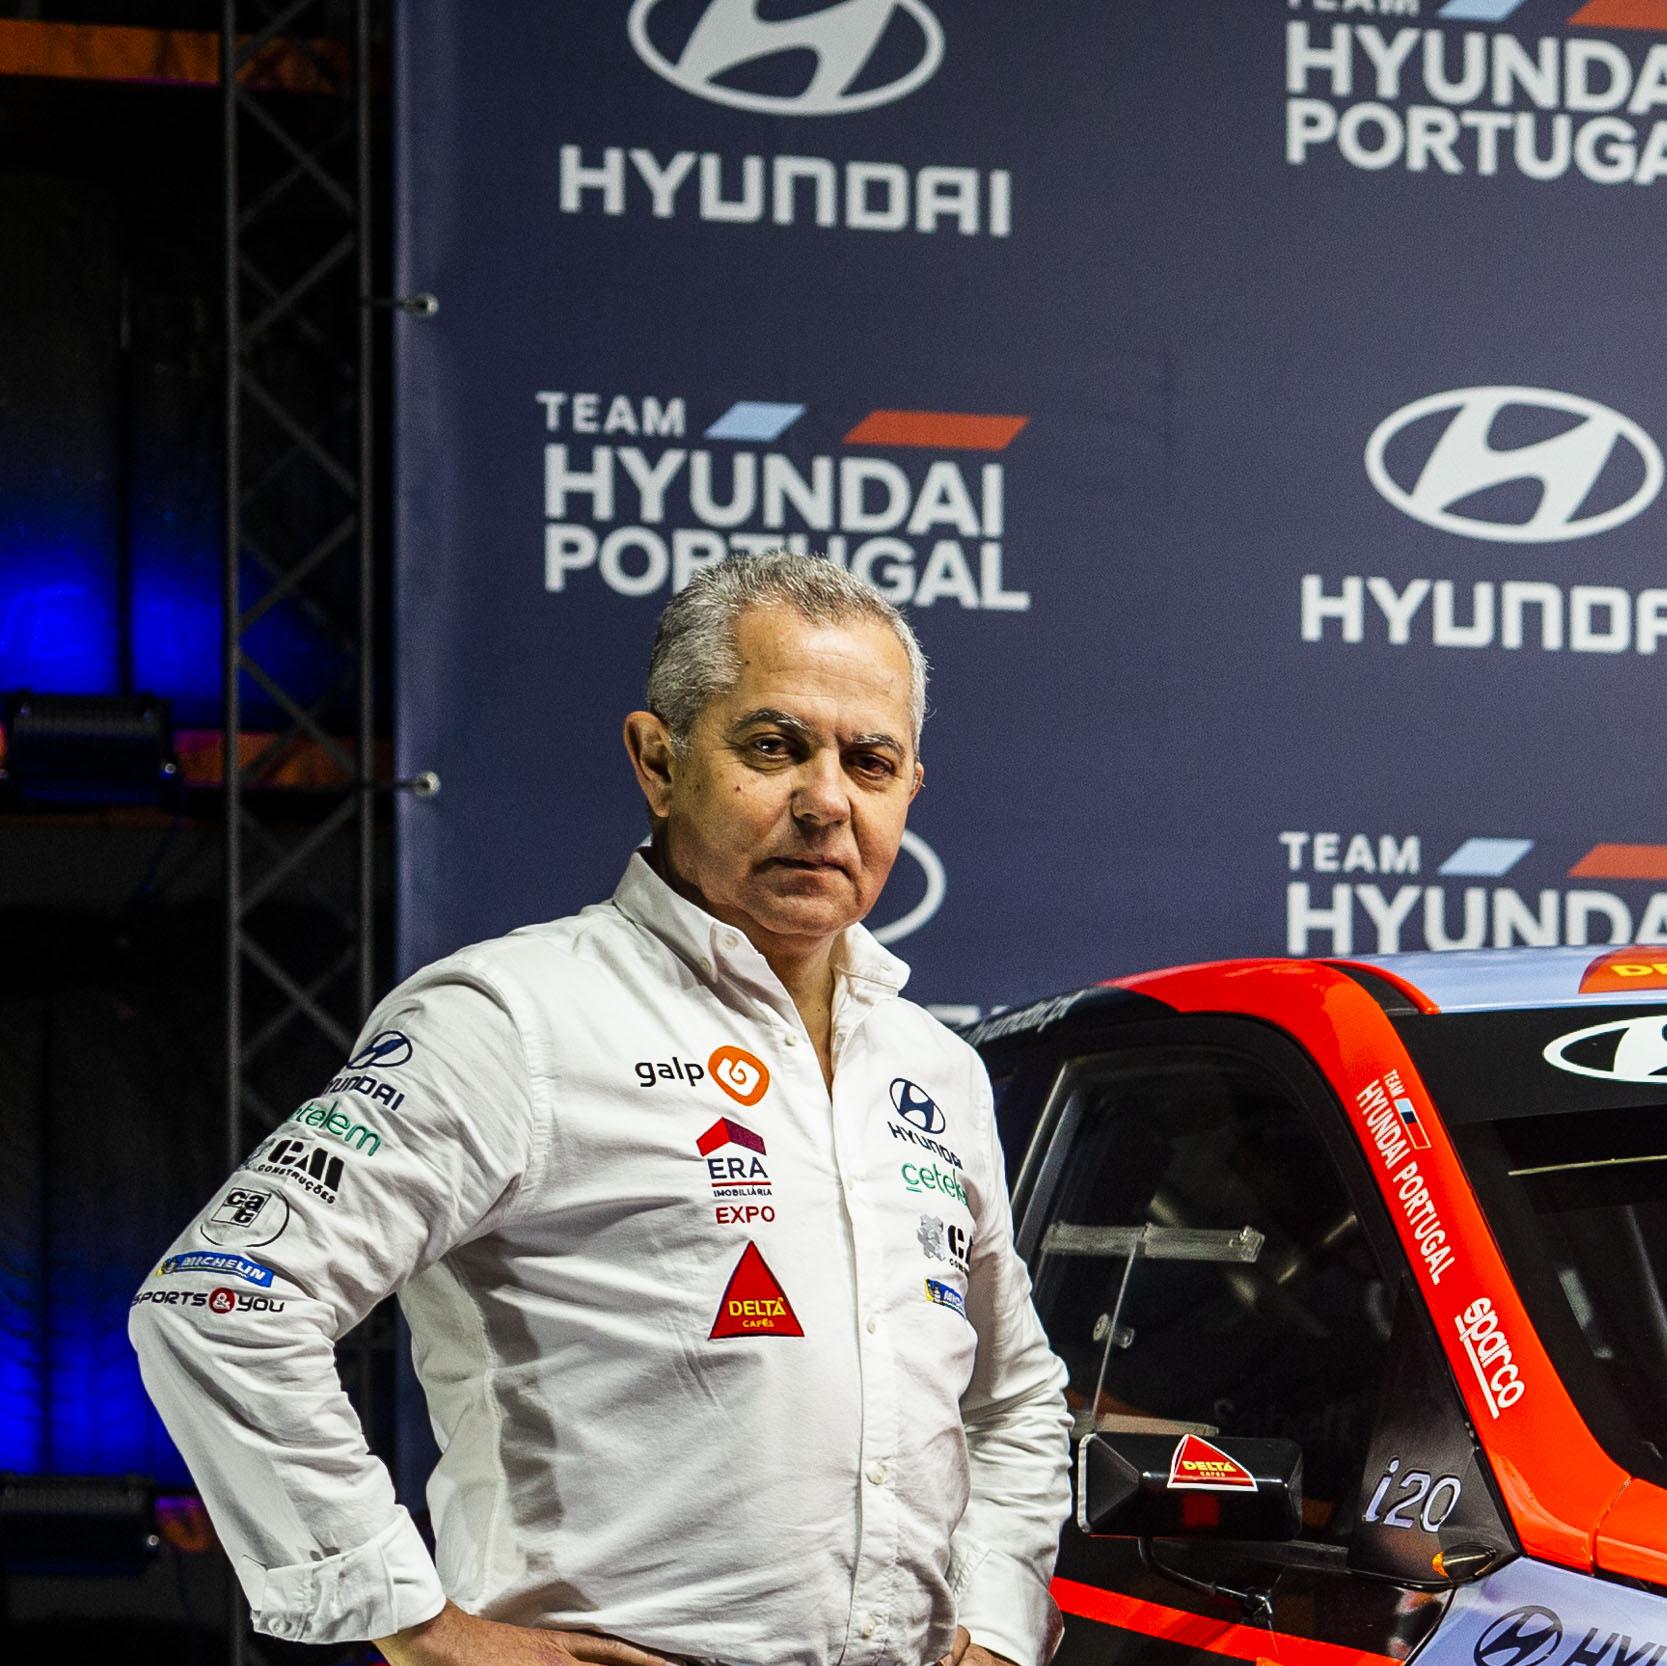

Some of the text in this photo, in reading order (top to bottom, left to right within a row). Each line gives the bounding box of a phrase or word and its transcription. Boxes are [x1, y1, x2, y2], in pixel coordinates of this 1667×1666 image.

[560, 145, 1011, 237] HYUNDAI
[536, 391, 686, 437] TEAM
[544, 444, 1005, 538] HYUNDAI
[545, 524, 1031, 611] PORGAL
[1279, 831, 1420, 875] TEAM
[323, 1075, 405, 1111] UNDAI
[635, 1057, 705, 1087] galp
[1383, 1069, 1405, 1098] TEAM
[296, 1101, 382, 1157] telem
[707, 1157, 768, 1180] ERA
[1356, 1079, 1455, 1285] HYUNDAI PORTUGAL
[716, 1206, 775, 1224] EXPO
[179, 1255, 266, 1281] MICHELIN
[1457, 1297, 1525, 1412] sparco
[1364, 1455, 1462, 1533] i20
